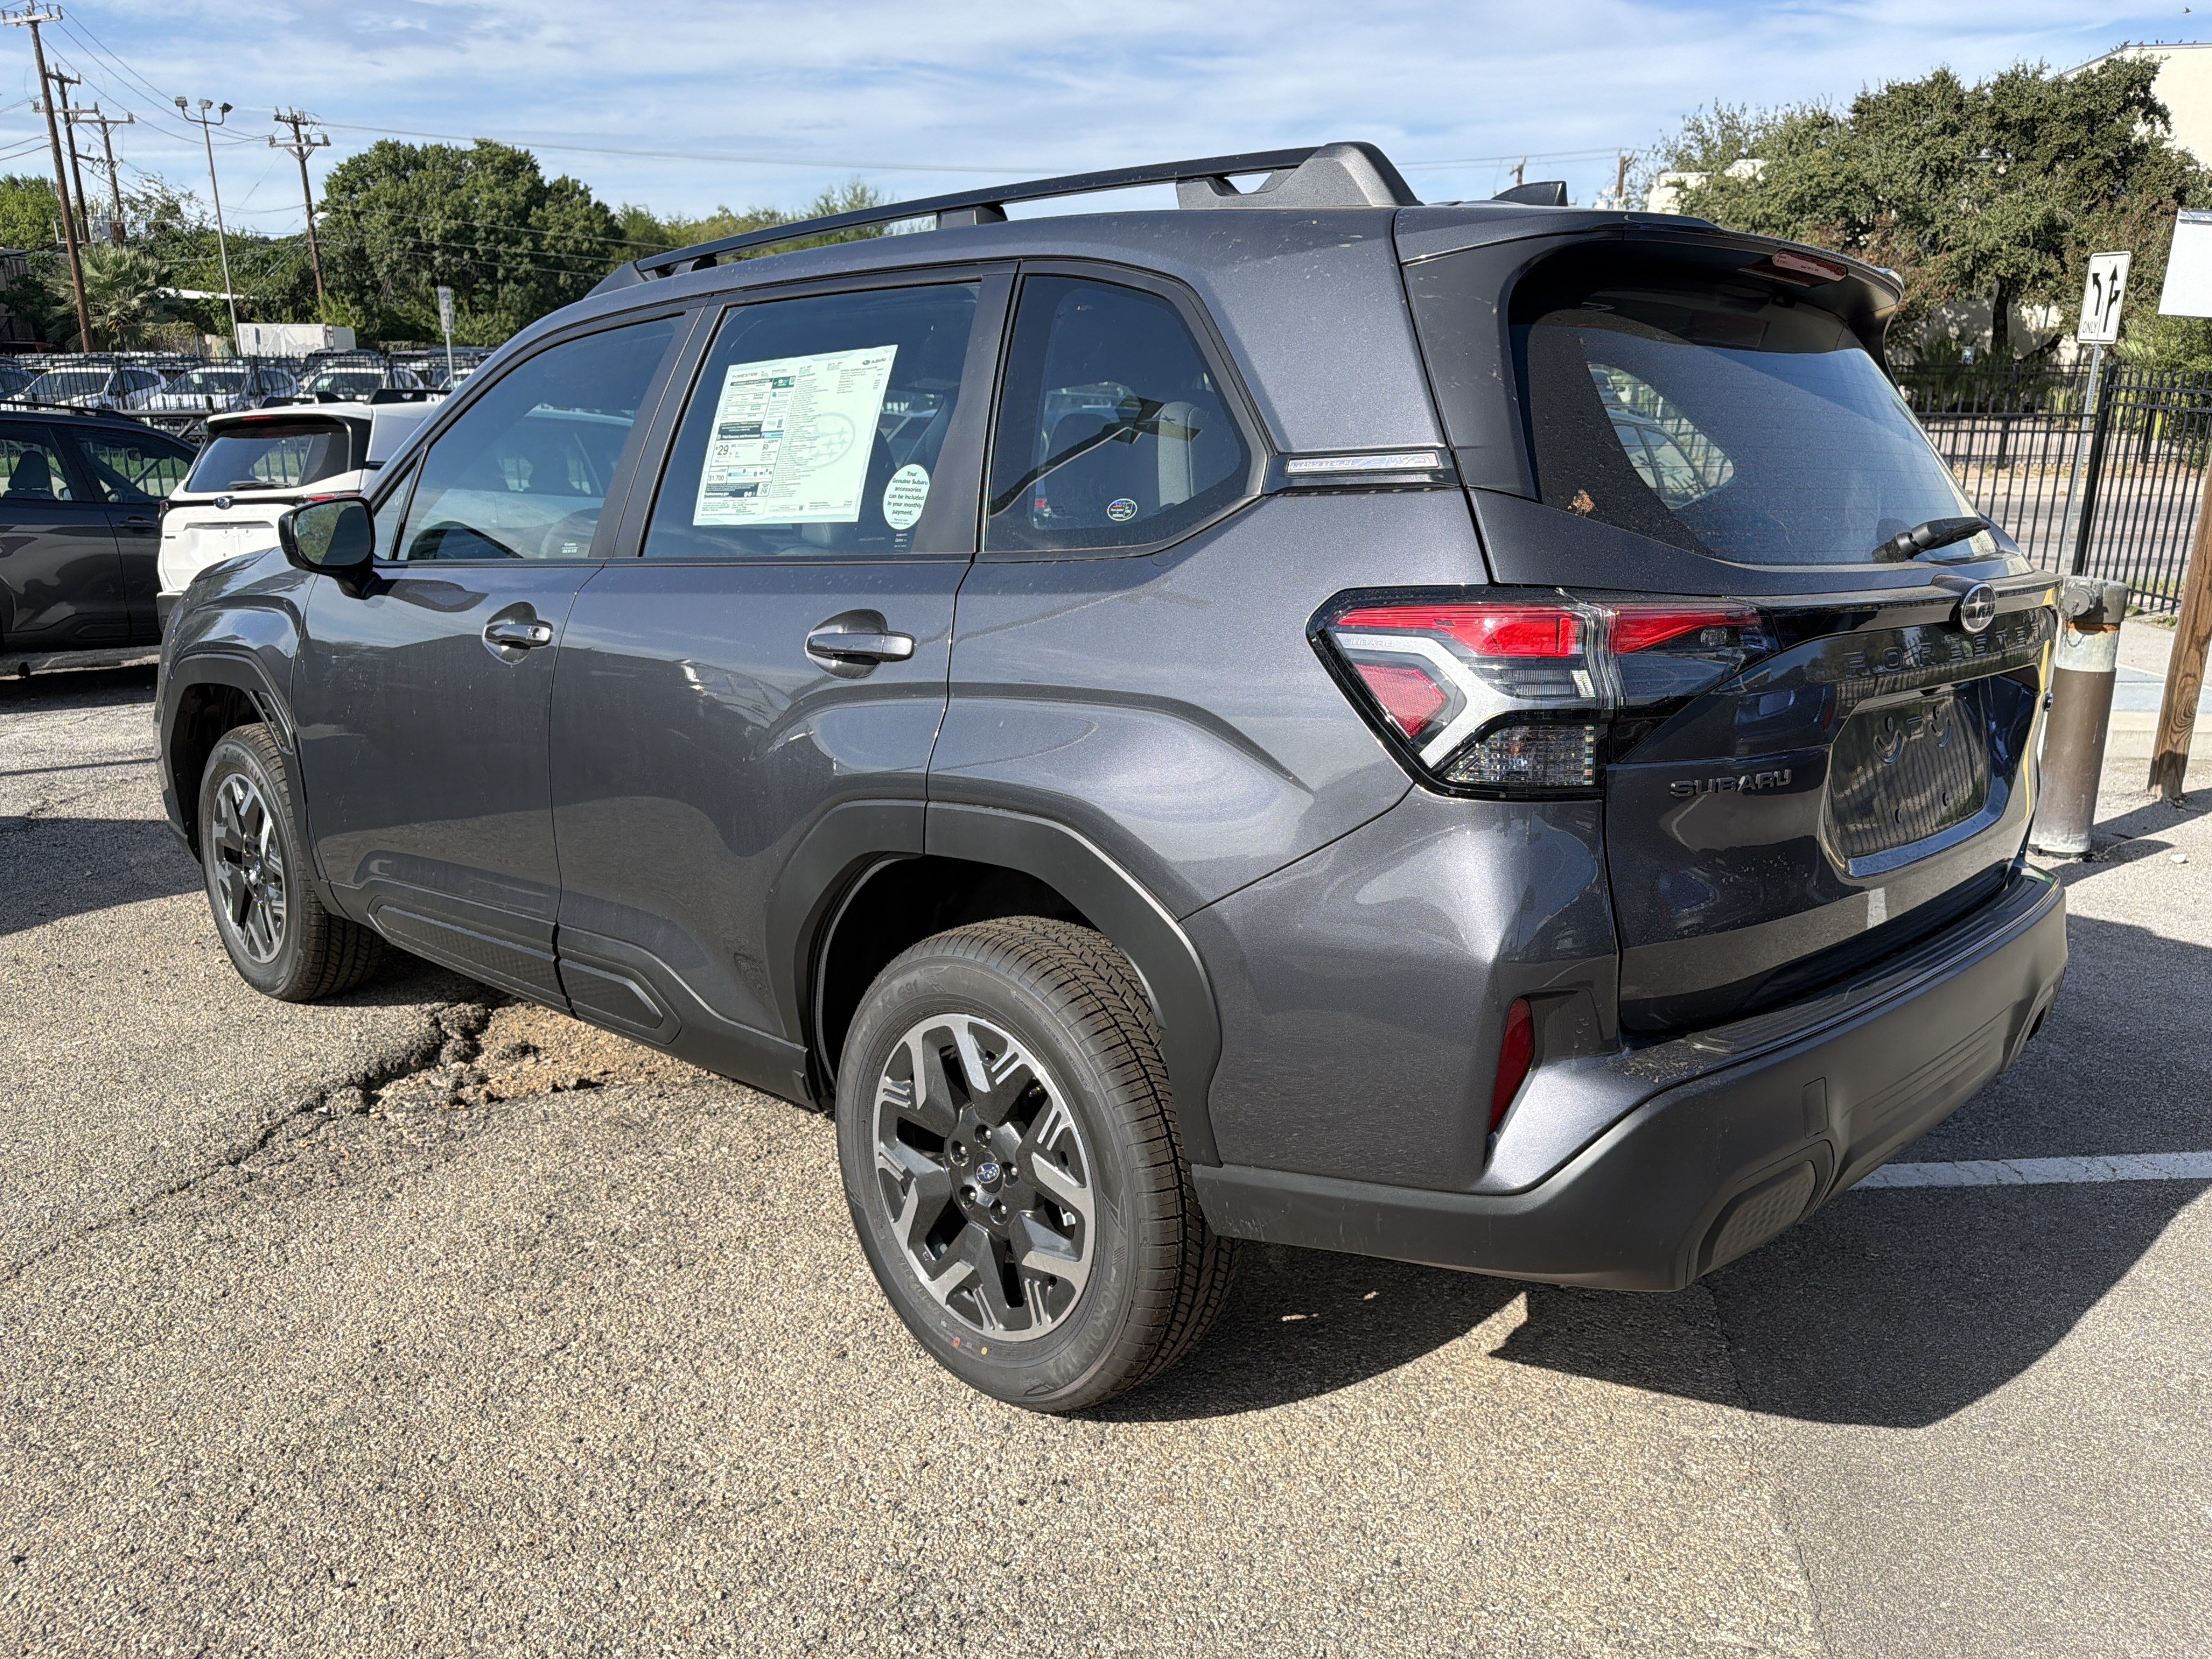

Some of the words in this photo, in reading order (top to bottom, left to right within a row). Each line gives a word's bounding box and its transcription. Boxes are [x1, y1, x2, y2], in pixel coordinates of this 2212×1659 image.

[2083, 321, 2098, 334] ONLY
[717, 445, 729, 455] 29
[1843, 623, 2042, 680] FORESTER
[1669, 769, 1792, 797] SUBARU
